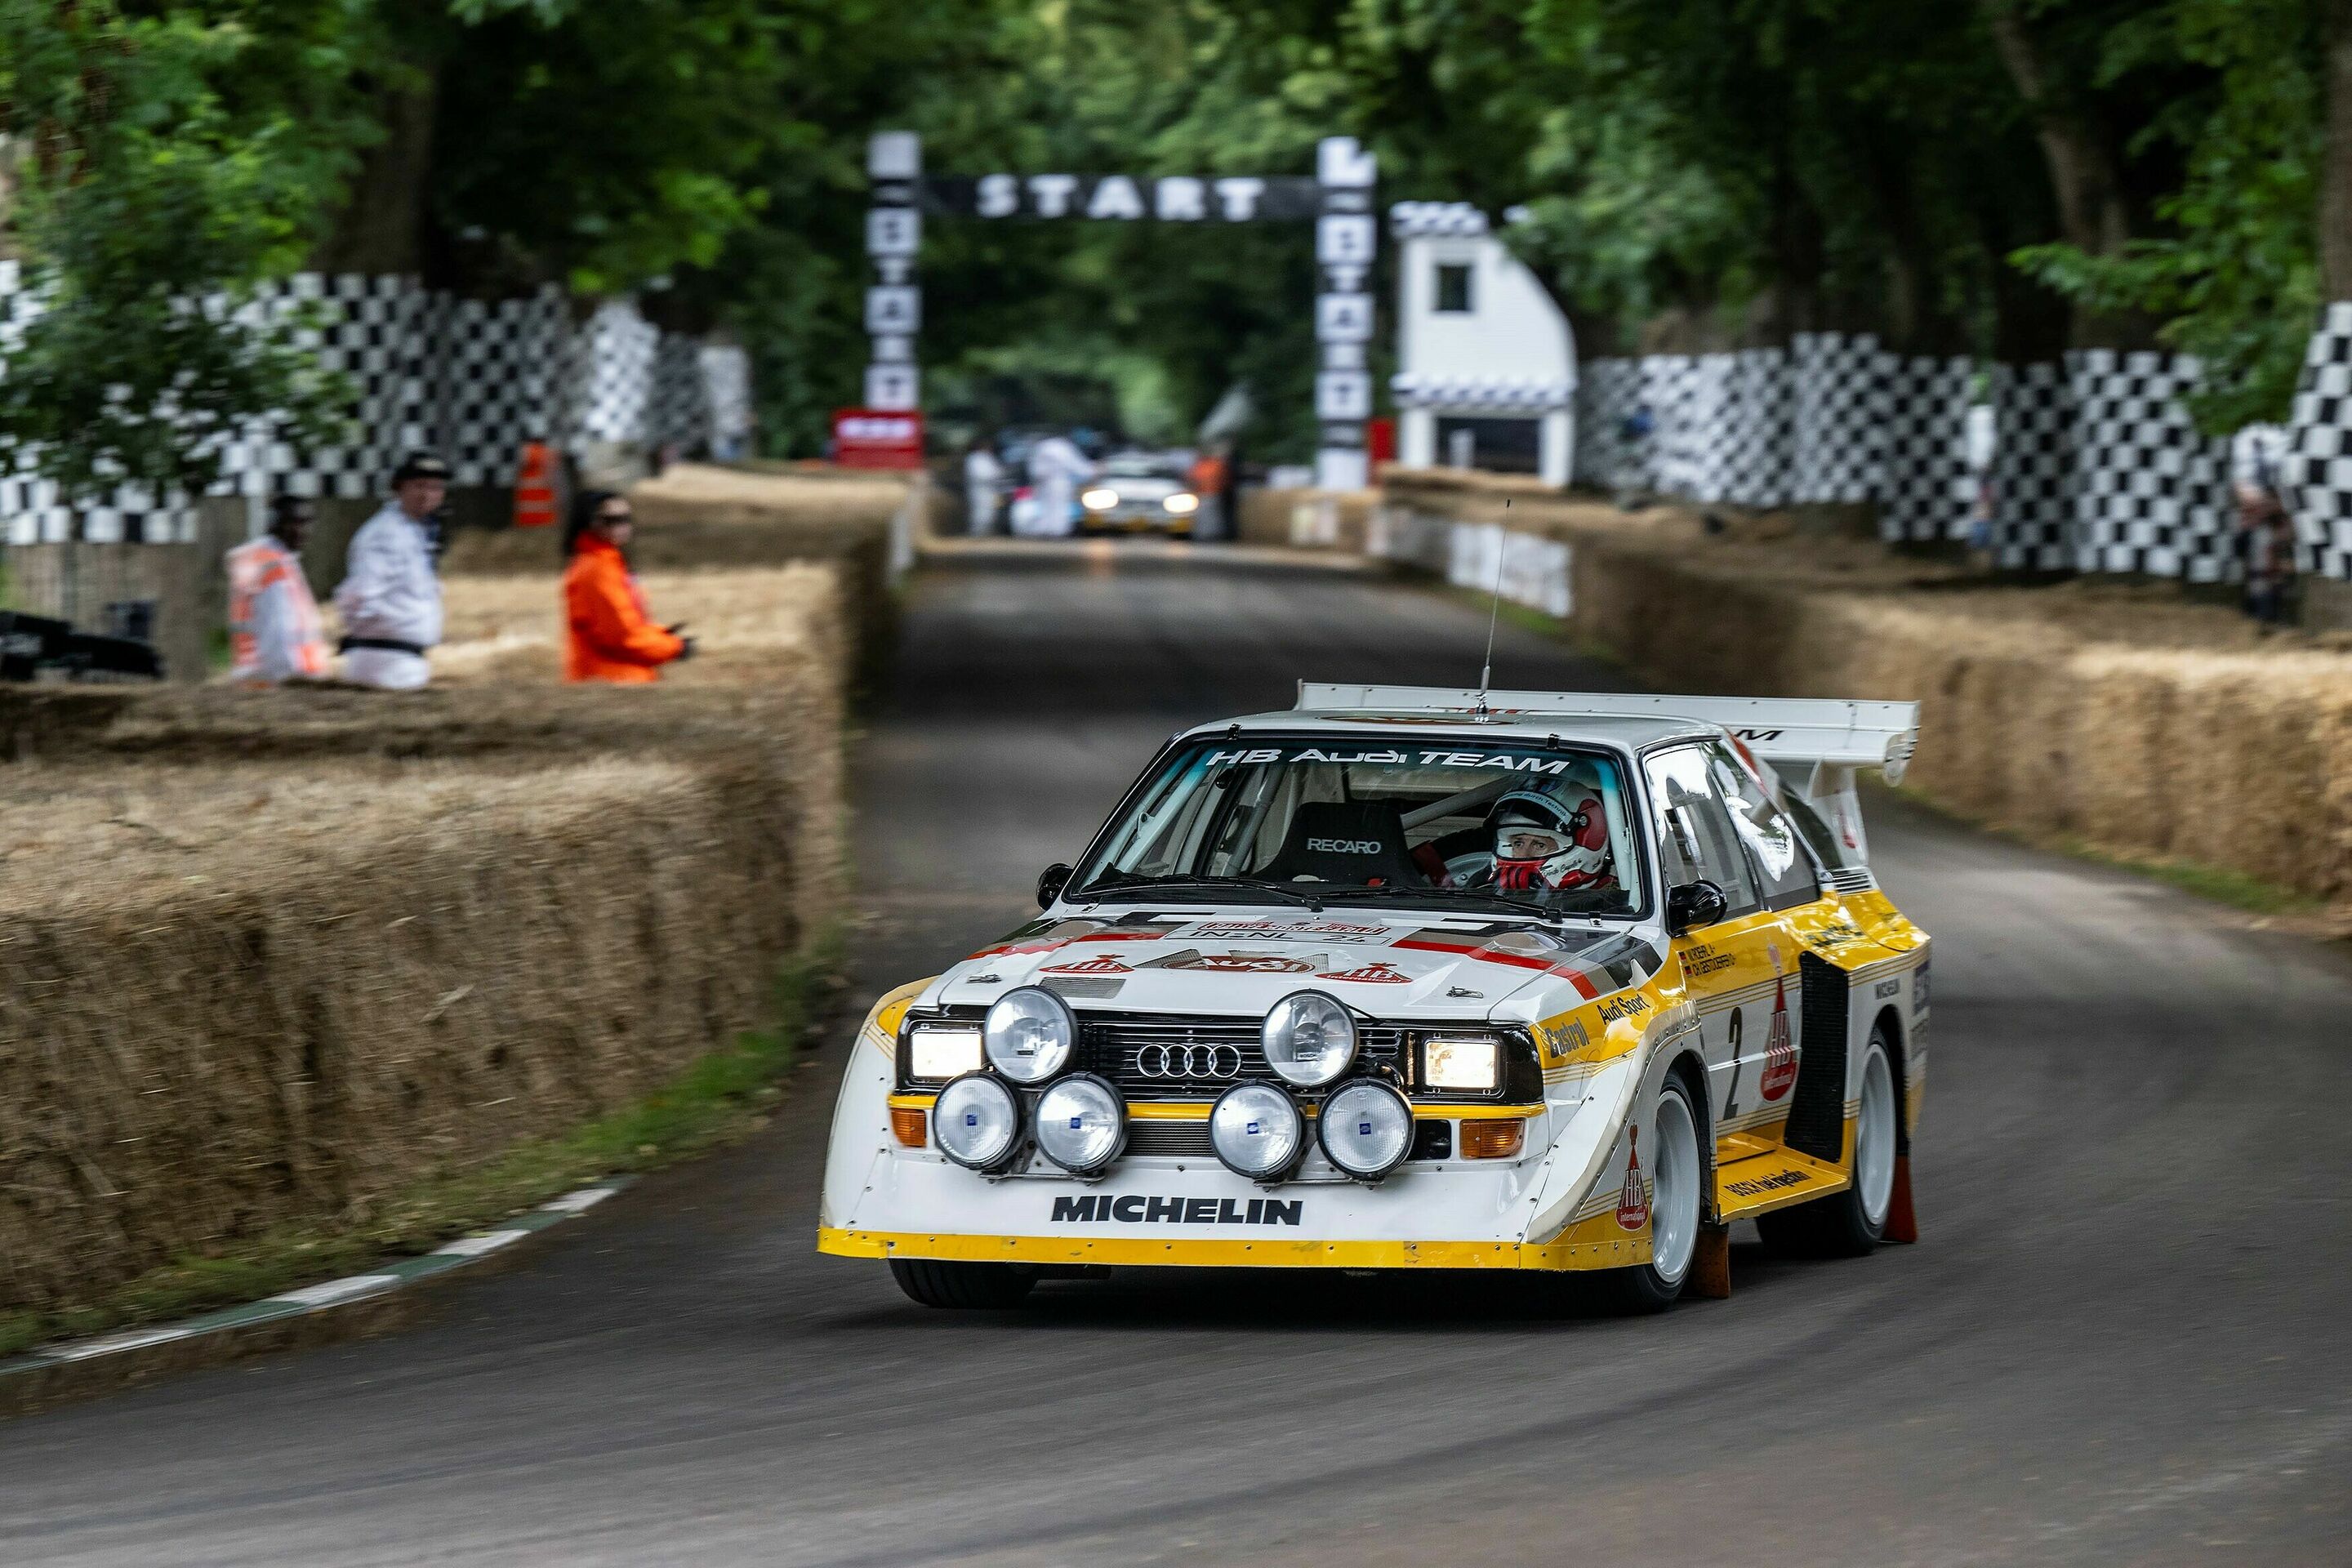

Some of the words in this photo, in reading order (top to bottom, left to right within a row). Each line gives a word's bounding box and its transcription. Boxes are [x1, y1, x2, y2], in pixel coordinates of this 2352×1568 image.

[977, 173, 1265, 222] START
[1206, 748, 1282, 766] HB
[1419, 751, 1570, 774] TEAM
[1307, 837, 1381, 854] RECARO
[1597, 999, 1625, 1025] Audi
[1617, 994, 1650, 1016] Sport
[1544, 1017, 1590, 1058] Castrol
[1723, 1006, 1743, 1120] 2
[1625, 1169, 1642, 1207] HB
[1050, 1195, 1303, 1226] MICHELIN
